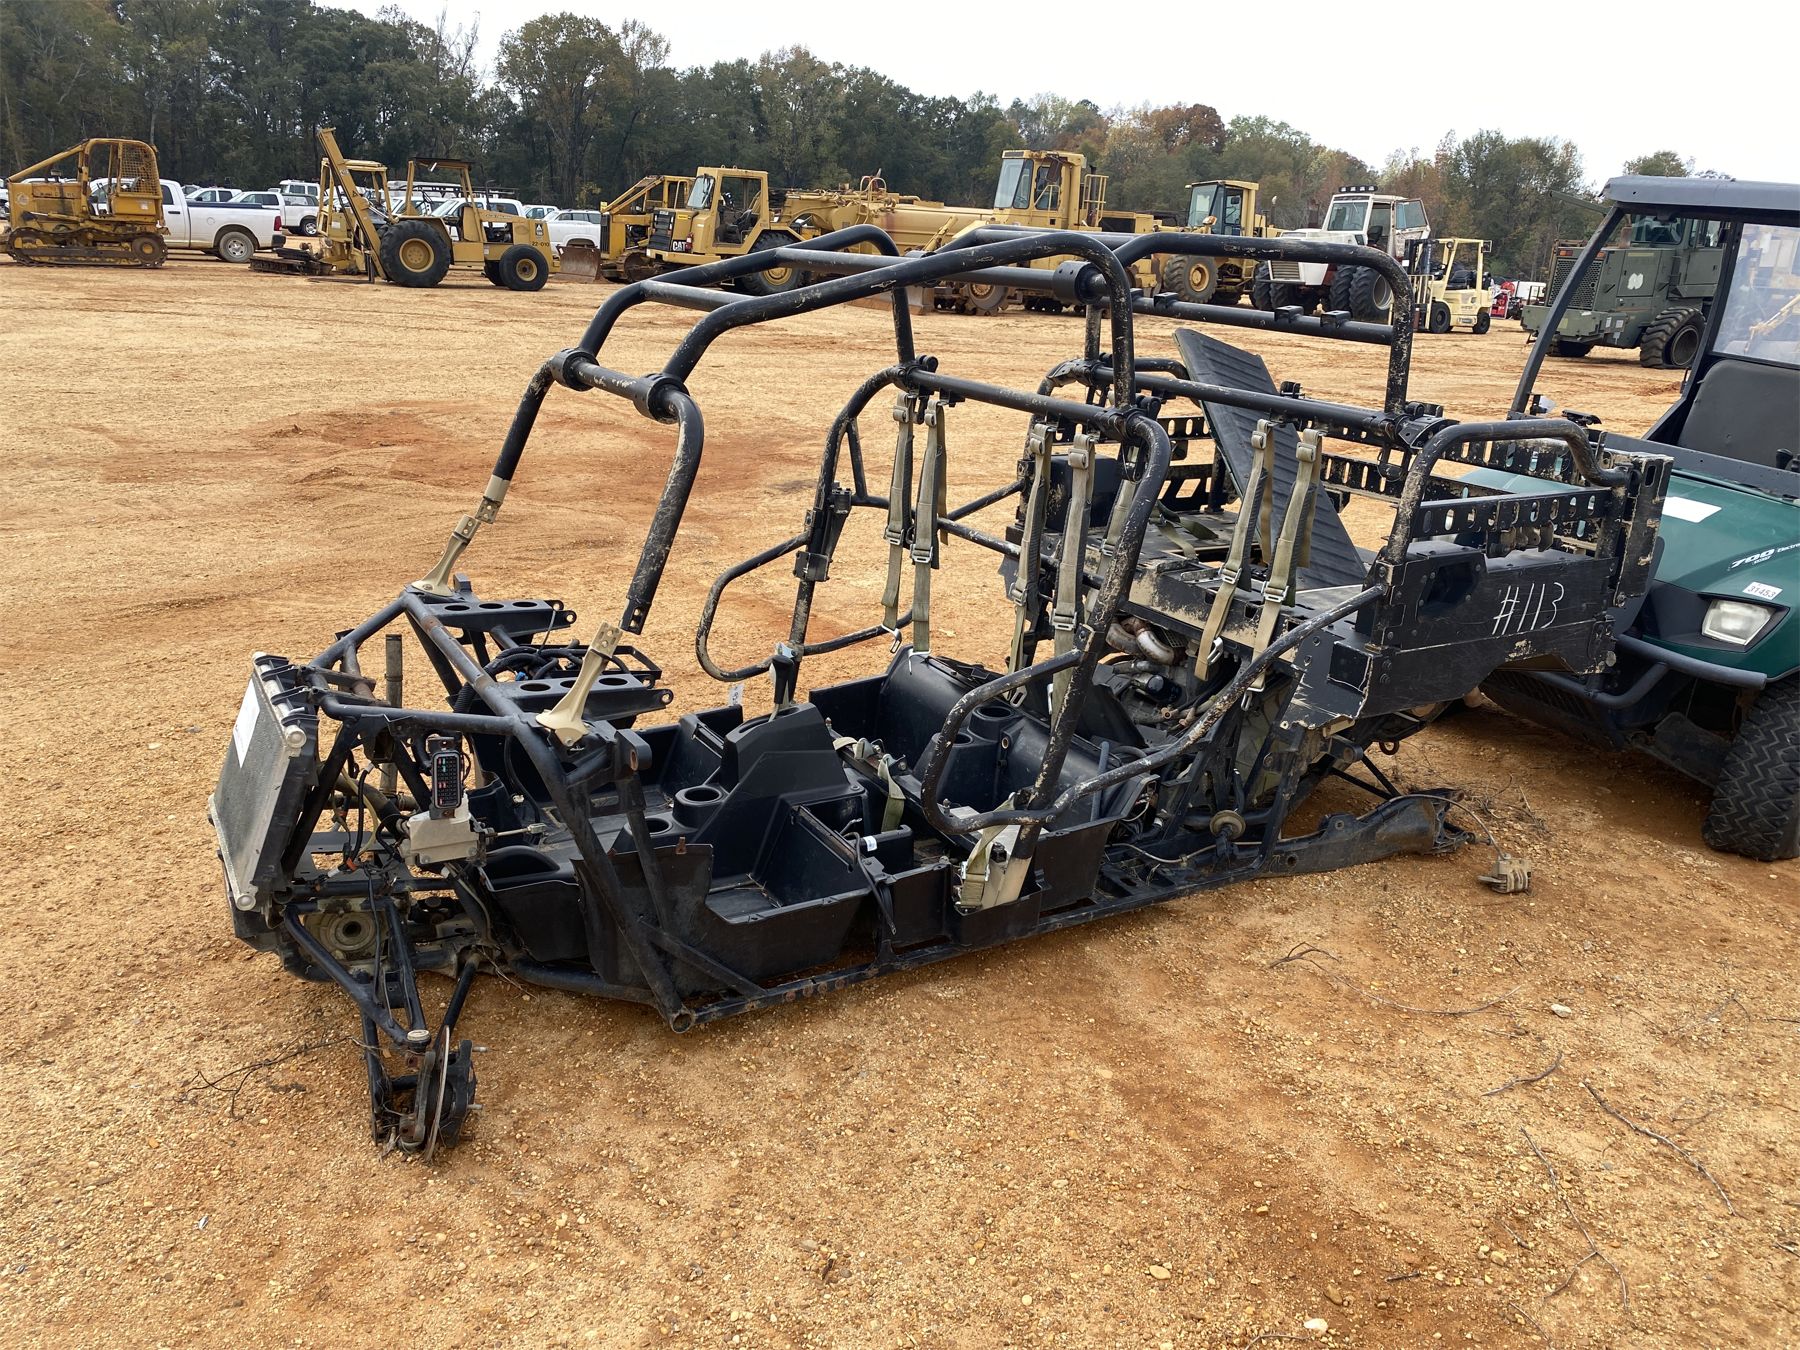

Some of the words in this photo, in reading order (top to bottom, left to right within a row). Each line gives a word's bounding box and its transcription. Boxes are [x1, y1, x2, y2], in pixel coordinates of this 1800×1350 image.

[672, 241, 687, 251] CAT
[1731, 549, 1775, 569] 700
[1491, 582, 1565, 635] #113
